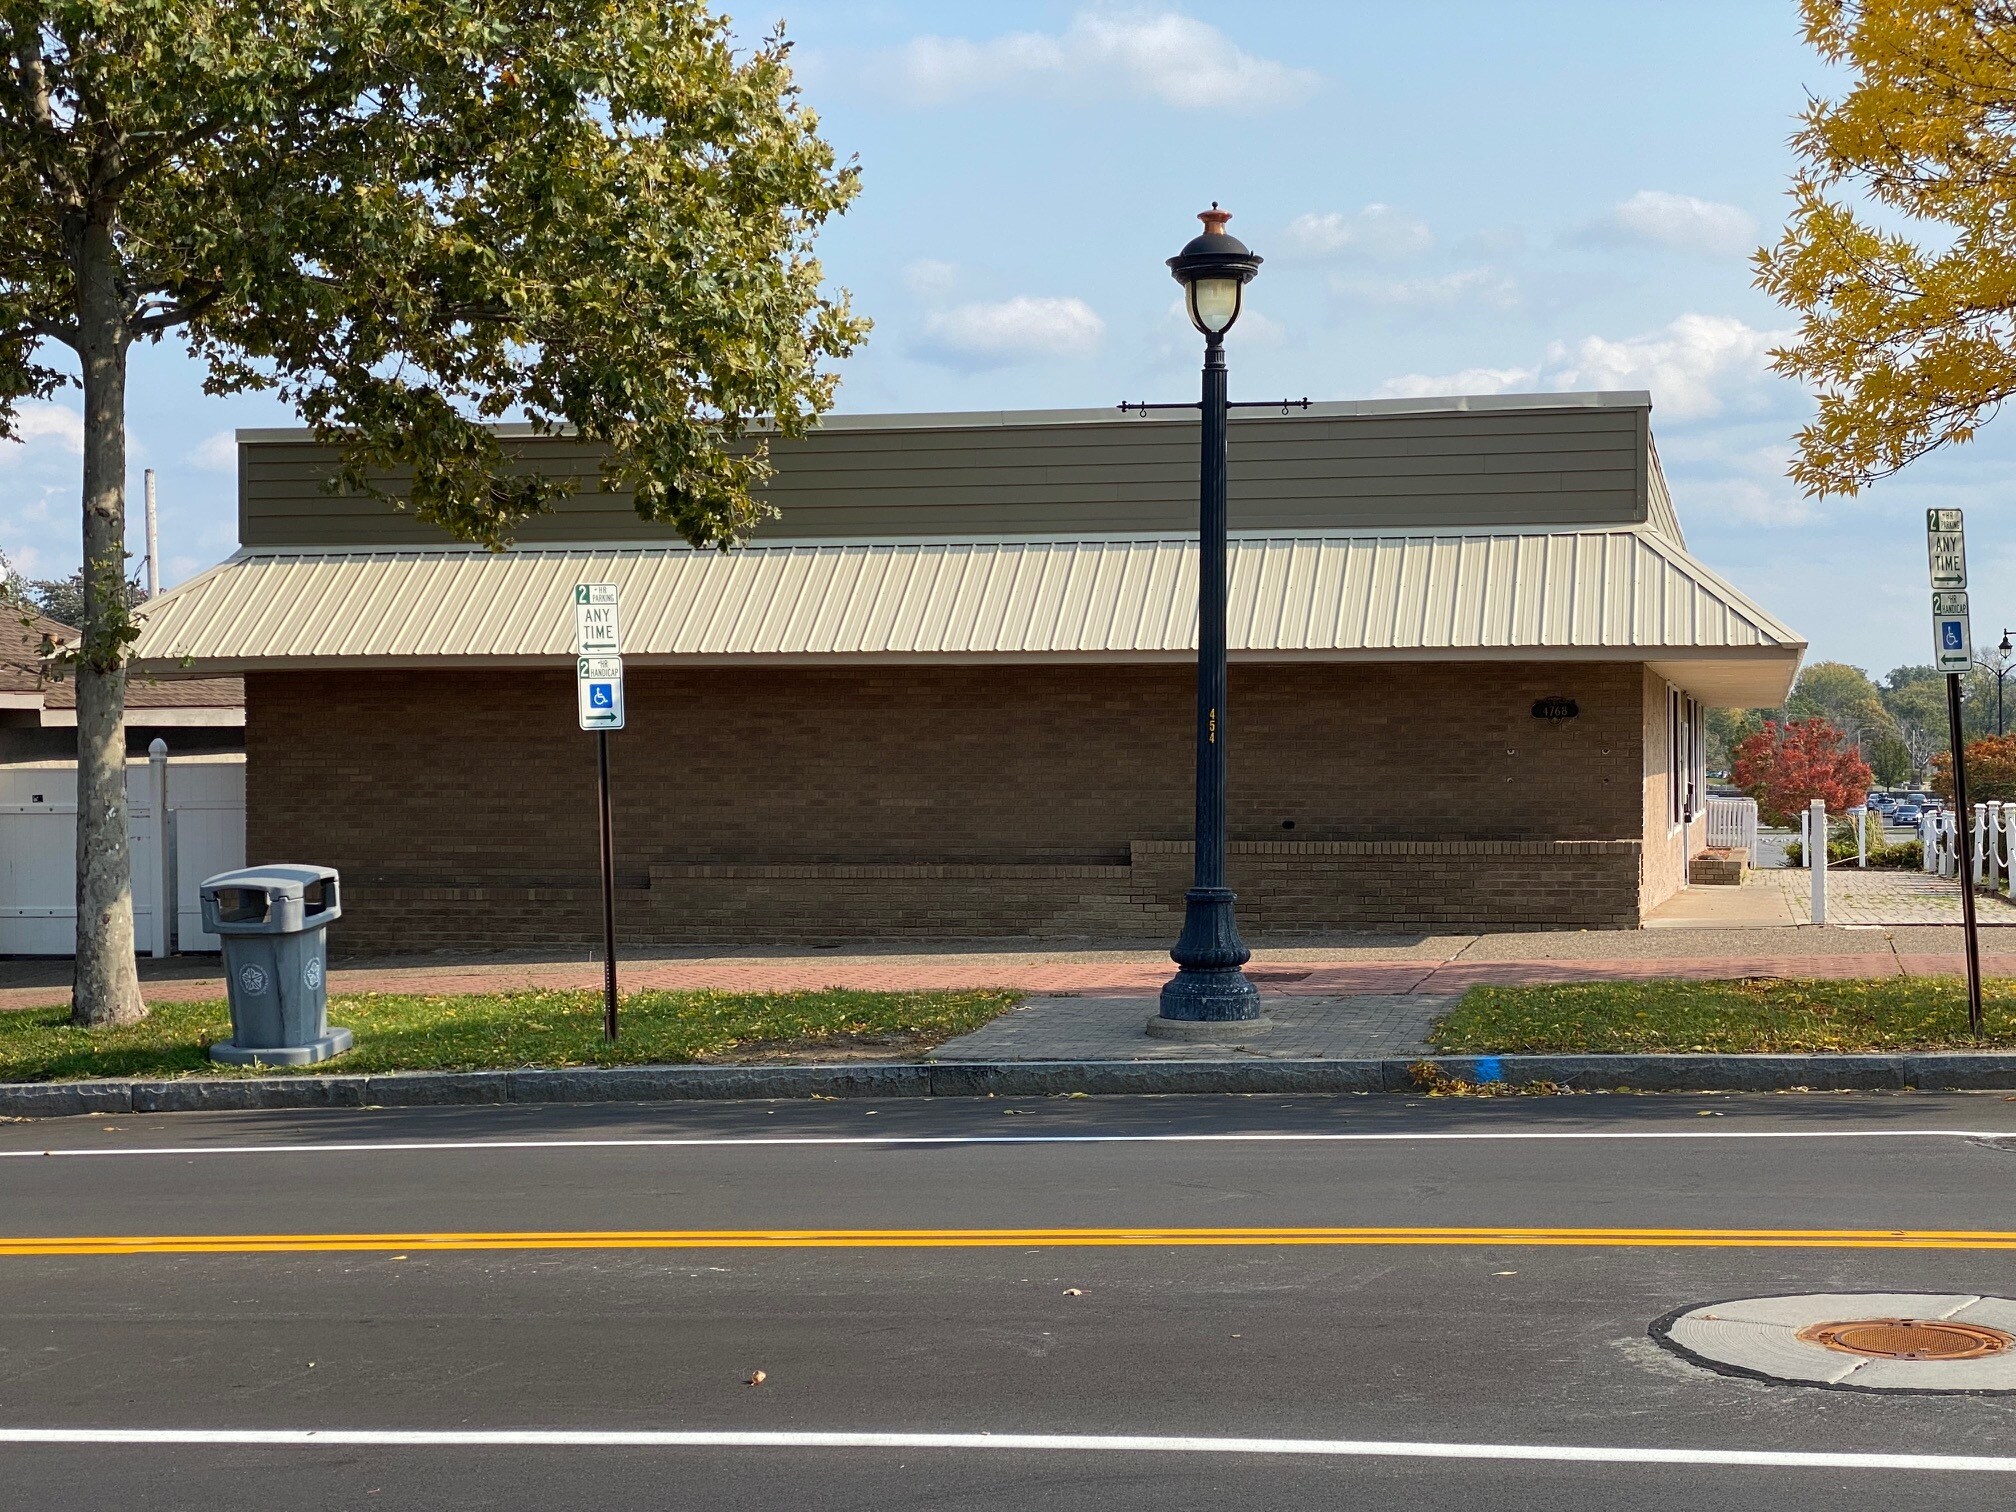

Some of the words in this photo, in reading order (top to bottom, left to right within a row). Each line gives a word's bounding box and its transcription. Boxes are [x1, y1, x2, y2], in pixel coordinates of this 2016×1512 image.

[1929, 510, 1937, 530] 2
[1945, 512, 1954, 520] HR
[1935, 536, 1957, 552] ANY
[1934, 556, 1960, 571] TIME
[578, 585, 587, 603] 2
[598, 586, 607, 594] HR
[592, 594, 615, 602] PARKING
[1933, 596, 1941, 614] 2
[1942, 604, 1967, 614] HANDICAP
[585, 608, 610, 623] ANY
[583, 625, 614, 639] TIME
[580, 660, 589, 677] 2
[600, 660, 608, 668] HR
[590, 668, 619, 677] HANDICAP
[1543, 705, 1568, 716] 4768
